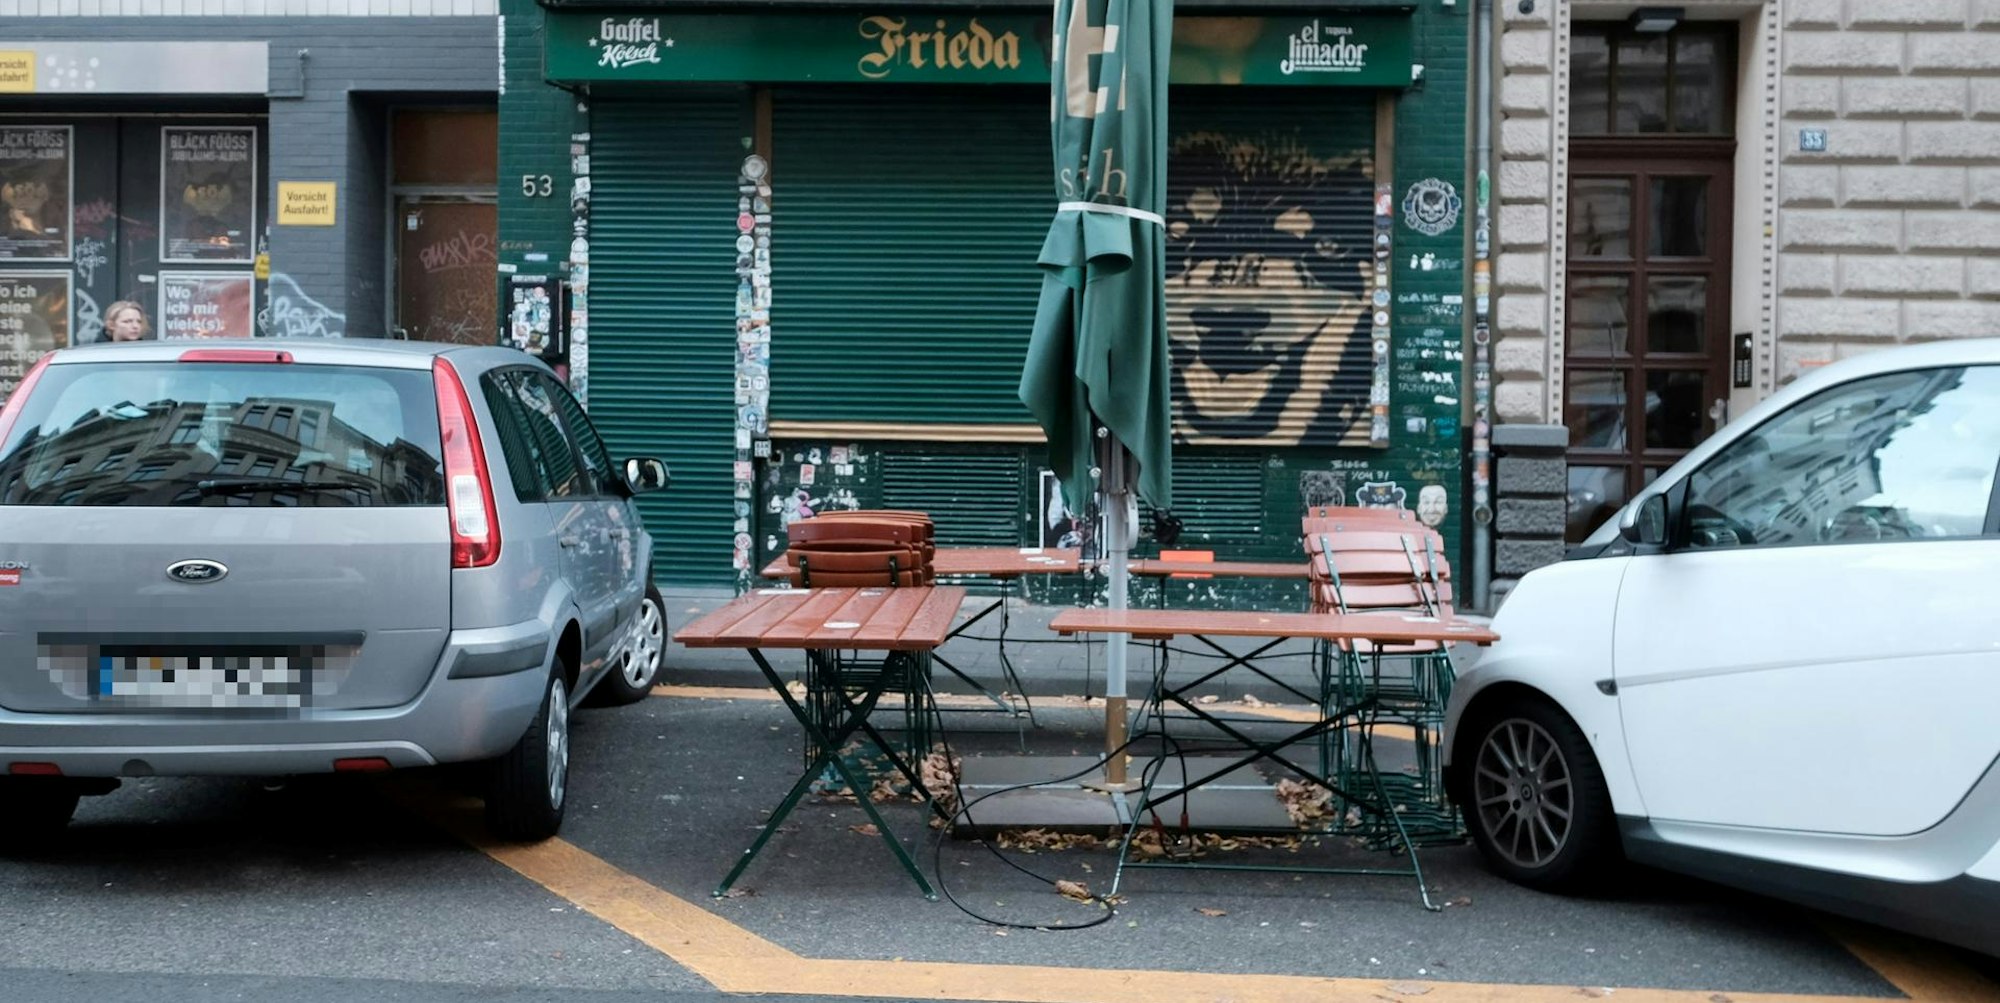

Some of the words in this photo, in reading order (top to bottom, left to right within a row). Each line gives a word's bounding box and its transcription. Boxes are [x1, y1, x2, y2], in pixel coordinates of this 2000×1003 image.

[600, 17, 662, 43] Gaffel
[1301, 19, 1319, 43] el
[598, 42, 661, 69] Kölsch
[857, 15, 1021, 78] Frieda
[1280, 33, 1368, 75] Jimador
[522, 174, 552, 197] 53
[286, 191, 327, 202] Vorsicht
[283, 204, 329, 215] Ausfahrt!
[13, 284, 37, 298] ich
[166, 285, 192, 299] Wo
[167, 301, 189, 314] ich
[193, 301, 219, 314] mir
[180, 564, 212, 578] Ford
